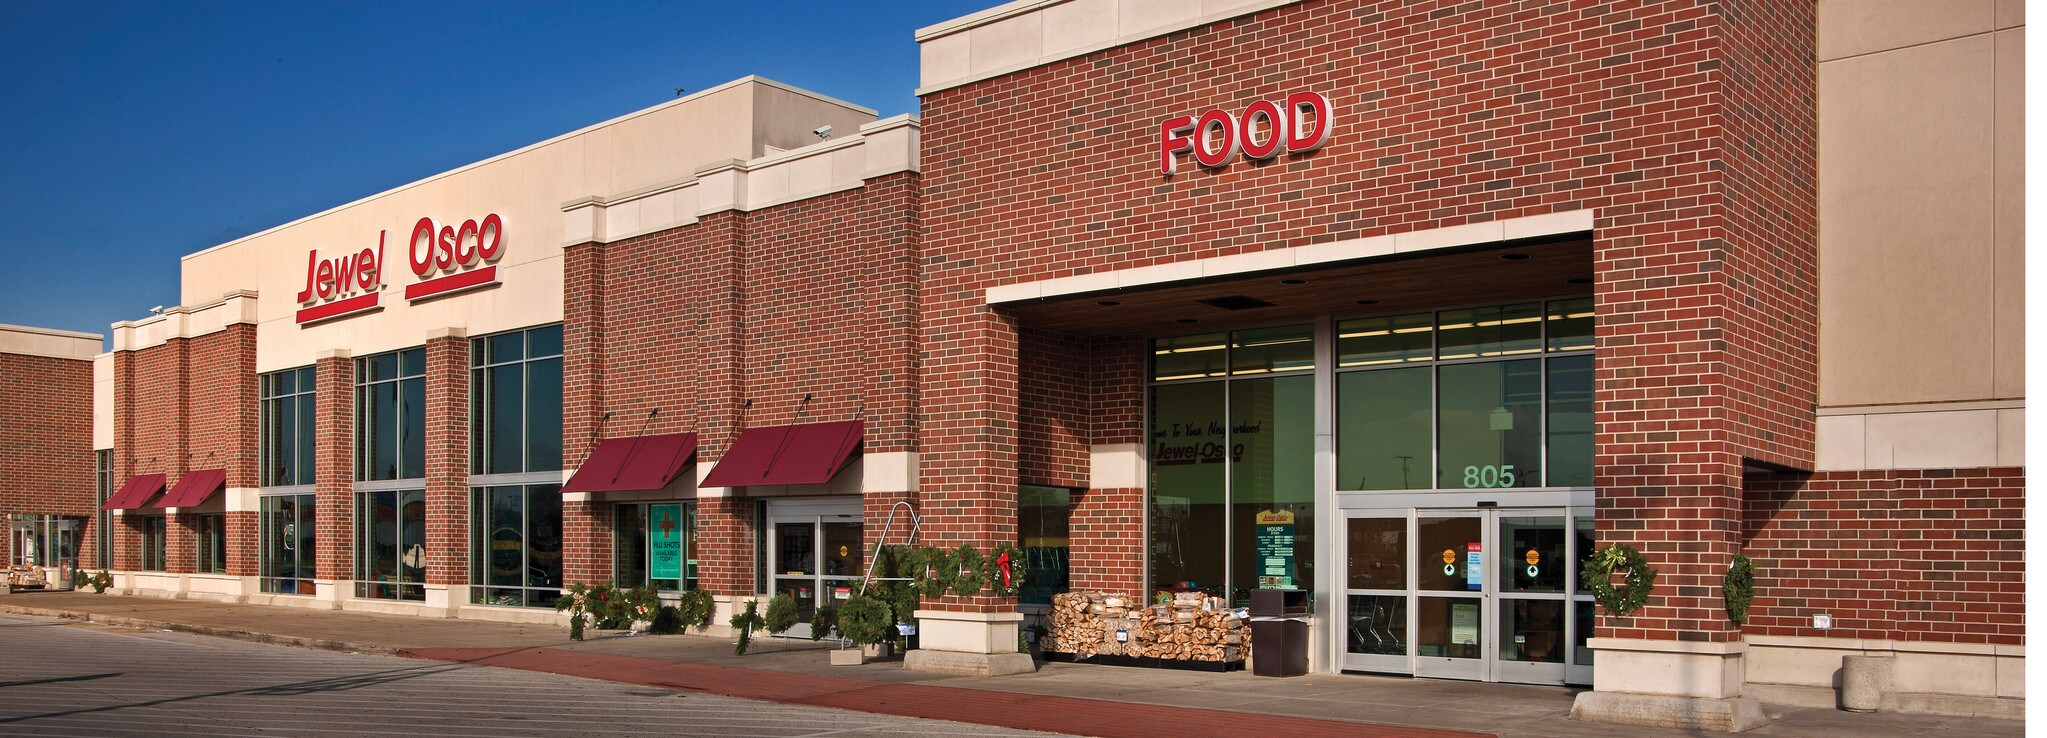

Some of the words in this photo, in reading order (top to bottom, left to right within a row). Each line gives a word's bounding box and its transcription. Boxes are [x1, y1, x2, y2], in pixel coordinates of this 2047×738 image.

[1161, 91, 1333, 175] FOOD
[297, 229, 390, 305] Jewel
[409, 213, 508, 277] Osco
[1172, 423, 1181, 438] To
[1186, 422, 1203, 437] Your
[1208, 419, 1261, 439] Neigorhood
[1156, 441, 1244, 459] Jewel-Oso
[1463, 465, 1515, 488] 805
[653, 541, 662, 549] FLU
[663, 541, 680, 549] SHOTS
